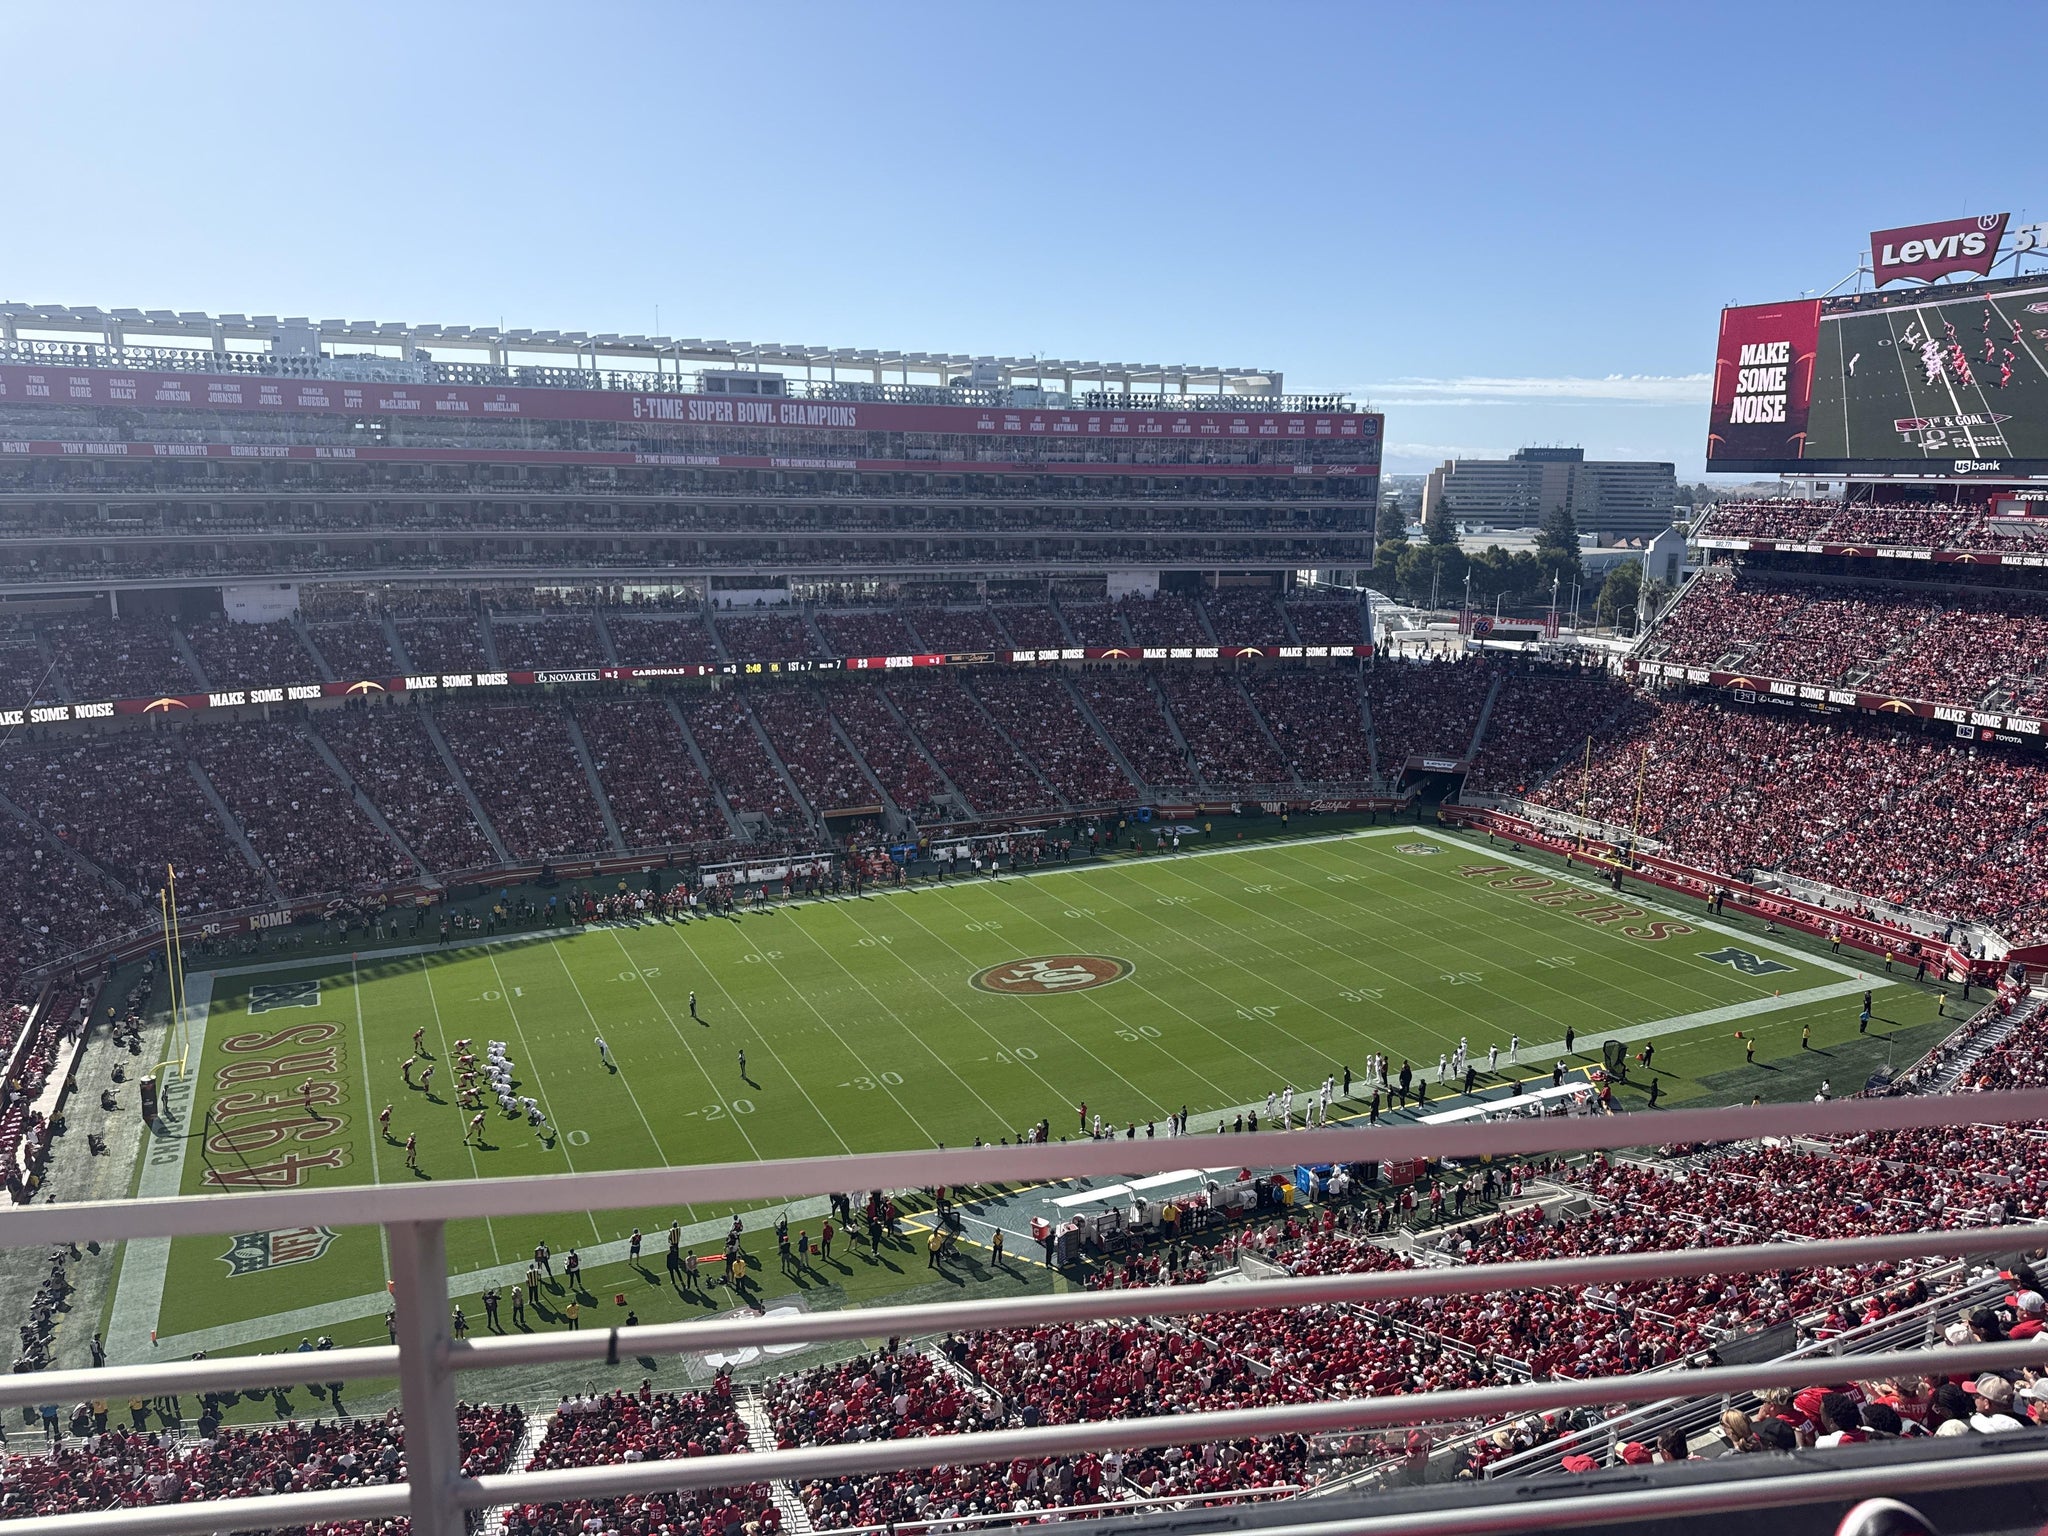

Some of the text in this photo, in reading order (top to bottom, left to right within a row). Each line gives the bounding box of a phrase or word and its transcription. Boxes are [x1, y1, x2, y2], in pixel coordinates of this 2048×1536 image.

[1739, 341, 1790, 365] MAKE
[28, 375, 45, 383] FRED
[69, 377, 90, 385] FRANK
[109, 379, 136, 387] CHARLES
[1736, 367, 1787, 393] SOME
[162, 381, 181, 389] JIMMY
[26, 385, 50, 397] DEAN
[70, 387, 92, 398] GORE
[110, 388, 136, 400] HALEY
[155, 390, 191, 402] JOHNSON
[208, 392, 243, 404] JOHNSON
[259, 394, 282, 405] JONES
[298, 395, 330, 407] KRUEGER
[344, 398, 363, 408] LOTT
[380, 399, 421, 410] McELHENNY
[436, 401, 469, 411] MONTANA
[483, 402, 520, 412] NOMELLINI
[1730, 394, 1787, 424] NOISE
[633, 398, 856, 427] 5-TIME SUPER BOWL CHAMPIONS
[977, 421, 995, 430] OWENS
[1945, 416, 1953, 426] &
[1955, 414, 1986, 426] GOAL
[1004, 422, 1021, 430] OWENS
[1029, 423, 1046, 431] PERRY
[1053, 423, 1079, 432] RATHMAN
[1088, 424, 1100, 432] RICE
[1172, 425, 1191, 433] TAYLOR
[1201, 425, 1220, 434] TITTLE
[1229, 425, 1249, 434] TURNER
[1315, 426, 1331, 435] YOUNG
[1341, 426, 1357, 435] YOUNG
[2, 442, 30, 453] McVAY
[62, 442, 128, 455] TONY MORABITO
[153, 443, 207, 456] VIC MORABITO
[231, 445, 289, 457] GEORGE SEIFERT
[316, 448, 356, 458] BILL WALSH
[660, 455, 685, 465] DIVISION
[686, 456, 720, 466] CHAMPIONS
[790, 459, 826, 468] CONFERENCE
[827, 460, 857, 469] CHAMPIONS
[1971, 460, 2001, 471] bank
[1293, 465, 1313, 474] HOME
[1326, 464, 1357, 475] Faithful
[1775, 543, 1823, 553] MAKE SOME NOISE
[1877, 549, 1931, 560] MAKE SOME NOISE
[2001, 556, 2022, 565] MAKE
[2023, 557, 2042, 566] SOME
[1476, 621, 1489, 631] 76
[1013, 649, 1084, 662] MAKE SOME NOISE
[1143, 648, 1218, 659] MAKE SOME NOISE
[1279, 646, 1353, 657] MAKE SOME NOISE
[788, 662, 799, 671] 1ST
[807, 661, 812, 670] 7
[836, 660, 841, 669] 7
[857, 656, 914, 668] 23 49ERS
[632, 665, 705, 677] CARDINALS 6
[731, 665, 737, 674] 3
[746, 663, 761, 673] 3:48
[1639, 662, 1710, 683] MAKE SOME NOISE
[405, 673, 508, 690] MAKE SOME NOISE
[549, 672, 597, 682] NOVARTIS
[208, 685, 321, 708] MAKE SOME NOISE
[1770, 681, 1796, 696] MAKE
[1800, 686, 1825, 701] SOME
[1828, 690, 1856, 706] NOISE
[1768, 697, 1794, 706] LEXUS
[0, 702, 114, 726] AKE SOME NOISE
[1933, 706, 2041, 735] MAKE SOME NOISE
[1995, 734, 2022, 744] TOYOTA
[1310, 800, 1351, 813] Faithful
[1454, 863, 1697, 942] 49ERS
[249, 909, 292, 930] HOME
[1536, 956, 1574, 969] 10
[1440, 972, 1480, 987] 20
[1338, 987, 1383, 1003] 30
[1235, 1004, 1277, 1022] 40
[1114, 1024, 1162, 1043] 50
[992, 1047, 1039, 1065] 40
[853, 1071, 904, 1092] 30
[203, 1022, 344, 1187] 49ERS
[699, 1100, 756, 1121] 20
[272, 1227, 323, 1264] NFL
